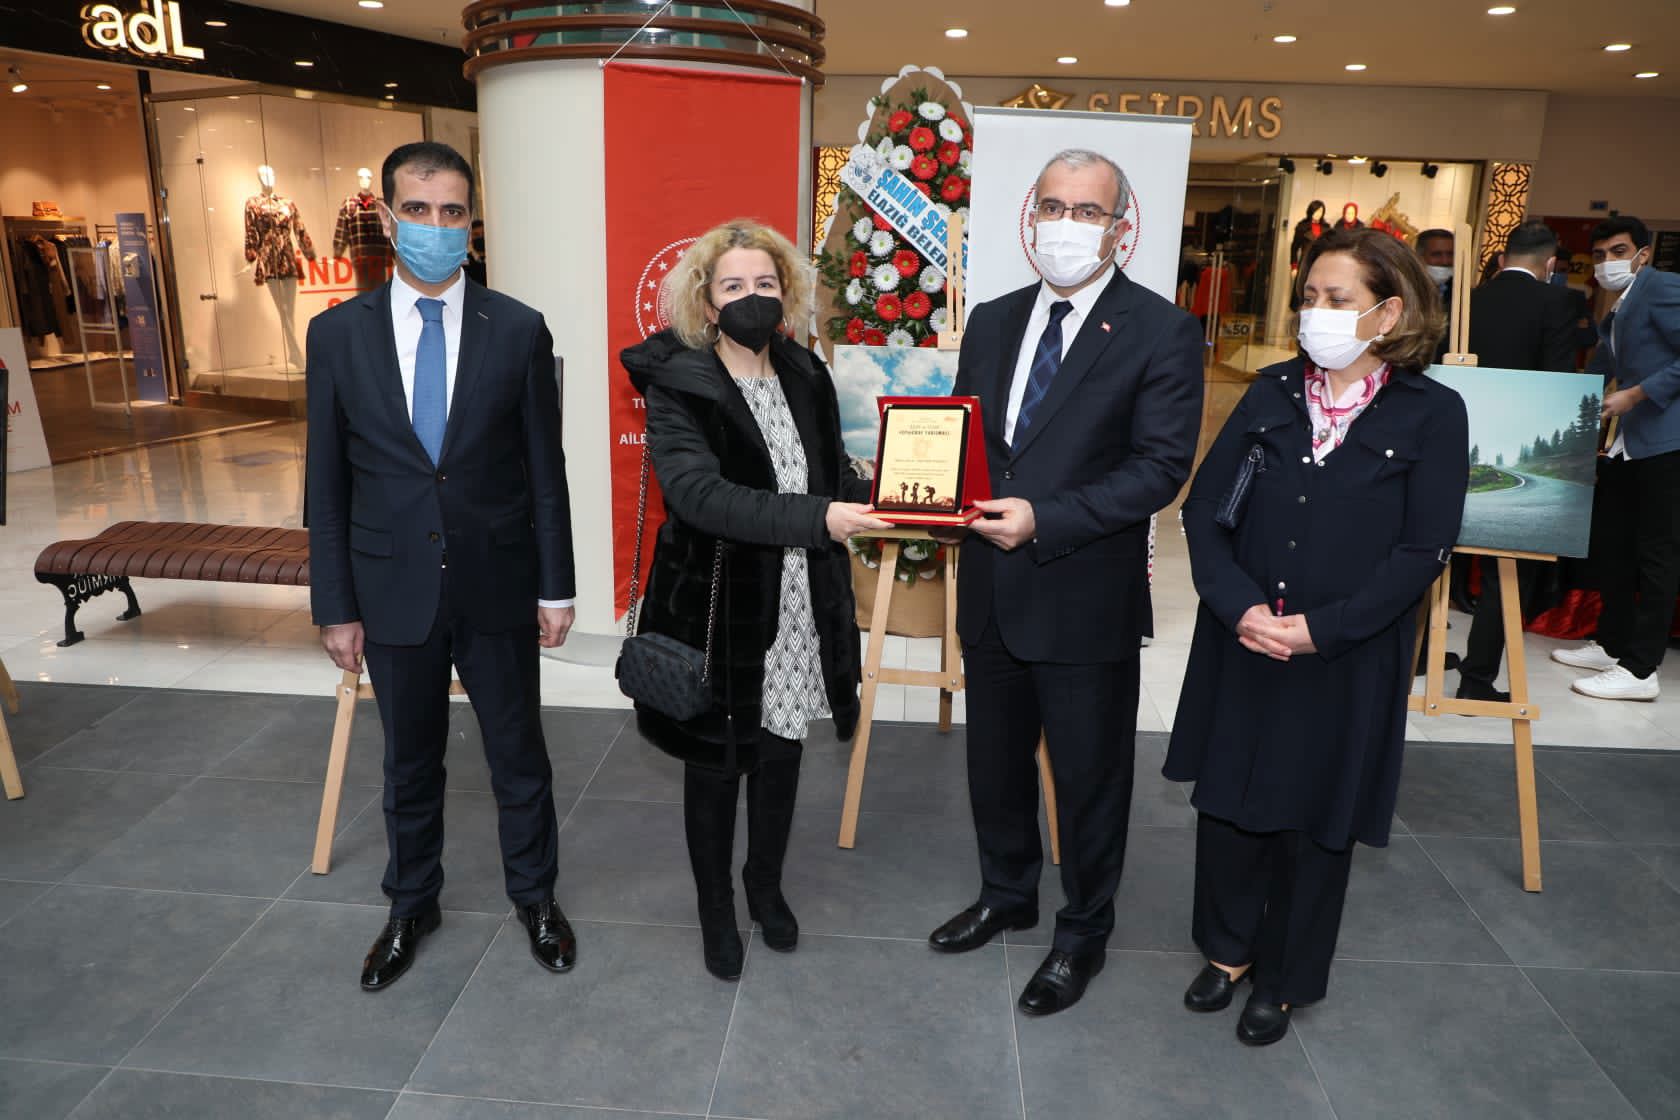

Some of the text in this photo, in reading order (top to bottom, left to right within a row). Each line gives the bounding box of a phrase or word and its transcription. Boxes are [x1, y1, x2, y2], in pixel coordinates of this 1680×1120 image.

[875, 168, 929, 218] ŞAHİN
[867, 189, 948, 273] ELAZIĞ BELED
